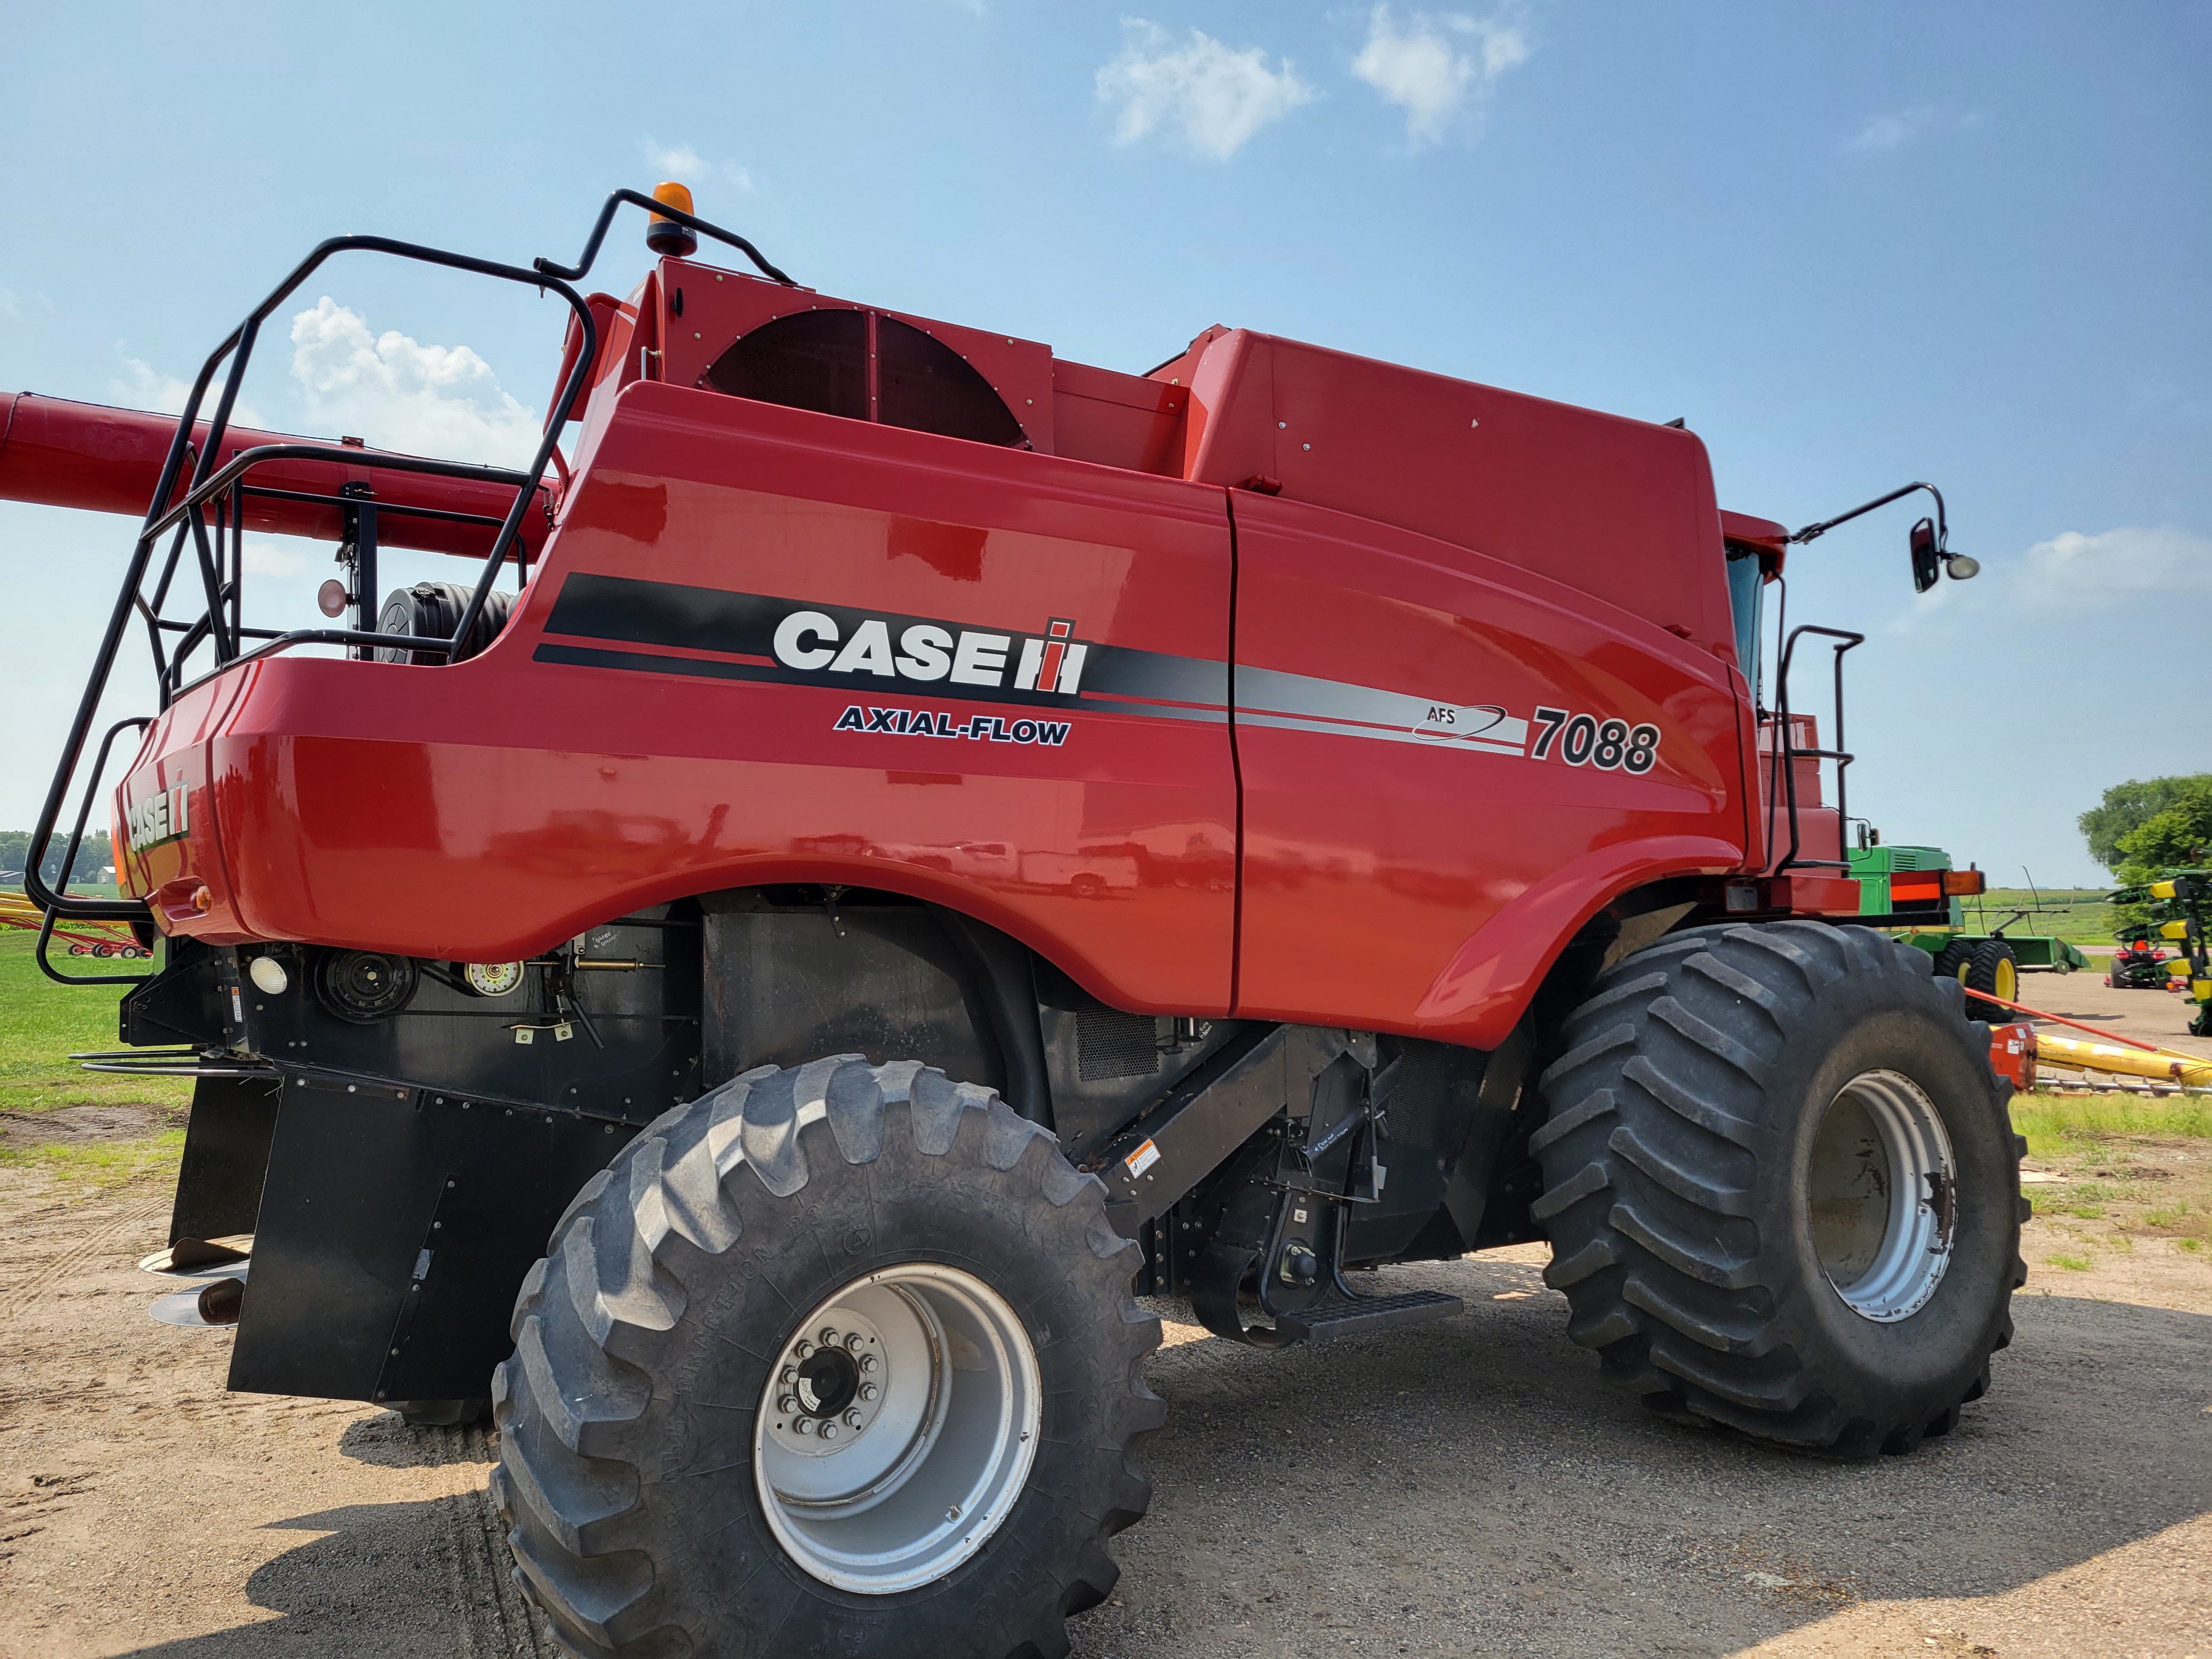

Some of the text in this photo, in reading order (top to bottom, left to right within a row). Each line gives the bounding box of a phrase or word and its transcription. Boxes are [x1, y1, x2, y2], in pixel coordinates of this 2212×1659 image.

[774, 611, 1011, 687] CASE
[833, 705, 1071, 746] AXIAL-FLOW
[1427, 706, 1456, 725] AFS
[1531, 705, 1661, 775] 7088
[128, 792, 168, 852] CASE
[674, 1241, 776, 1396] TRACTION
[786, 1204, 823, 1236] 23
[827, 1611, 878, 1626] TUBELESS
